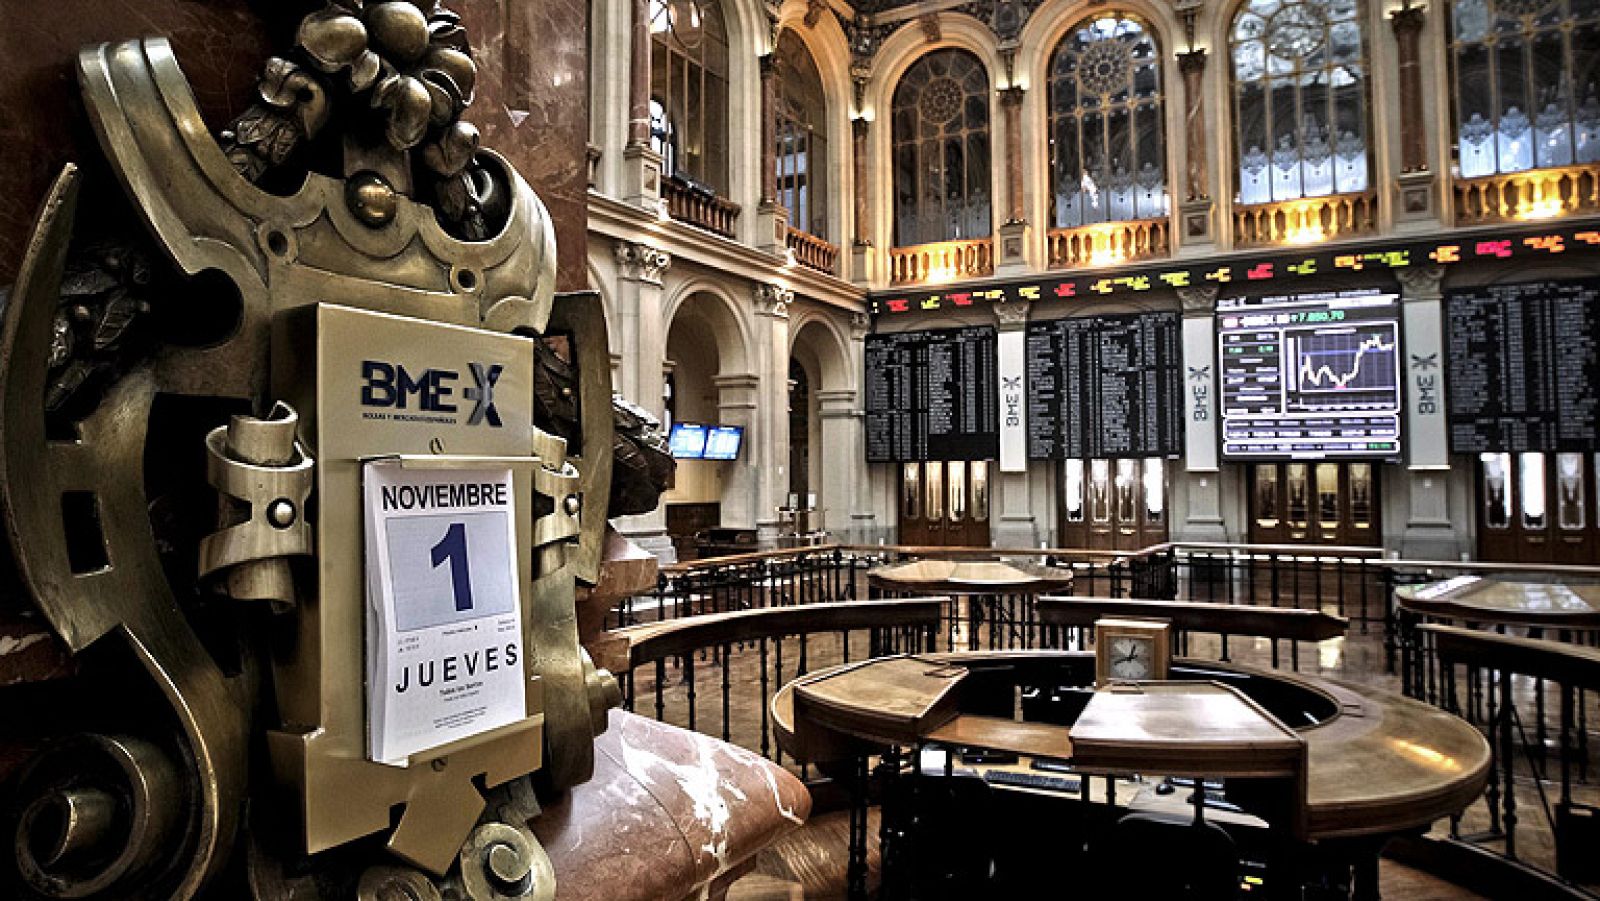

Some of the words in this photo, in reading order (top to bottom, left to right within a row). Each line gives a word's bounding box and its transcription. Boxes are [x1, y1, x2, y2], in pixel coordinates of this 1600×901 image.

[361, 361, 458, 413] BME
[1192, 386, 1207, 421] BME
[1416, 375, 1435, 415] BME
[1006, 394, 1019, 426] BME
[381, 483, 507, 512] NOVIEMBRE
[431, 523, 474, 612] 1
[396, 643, 518, 693] JUEVES
